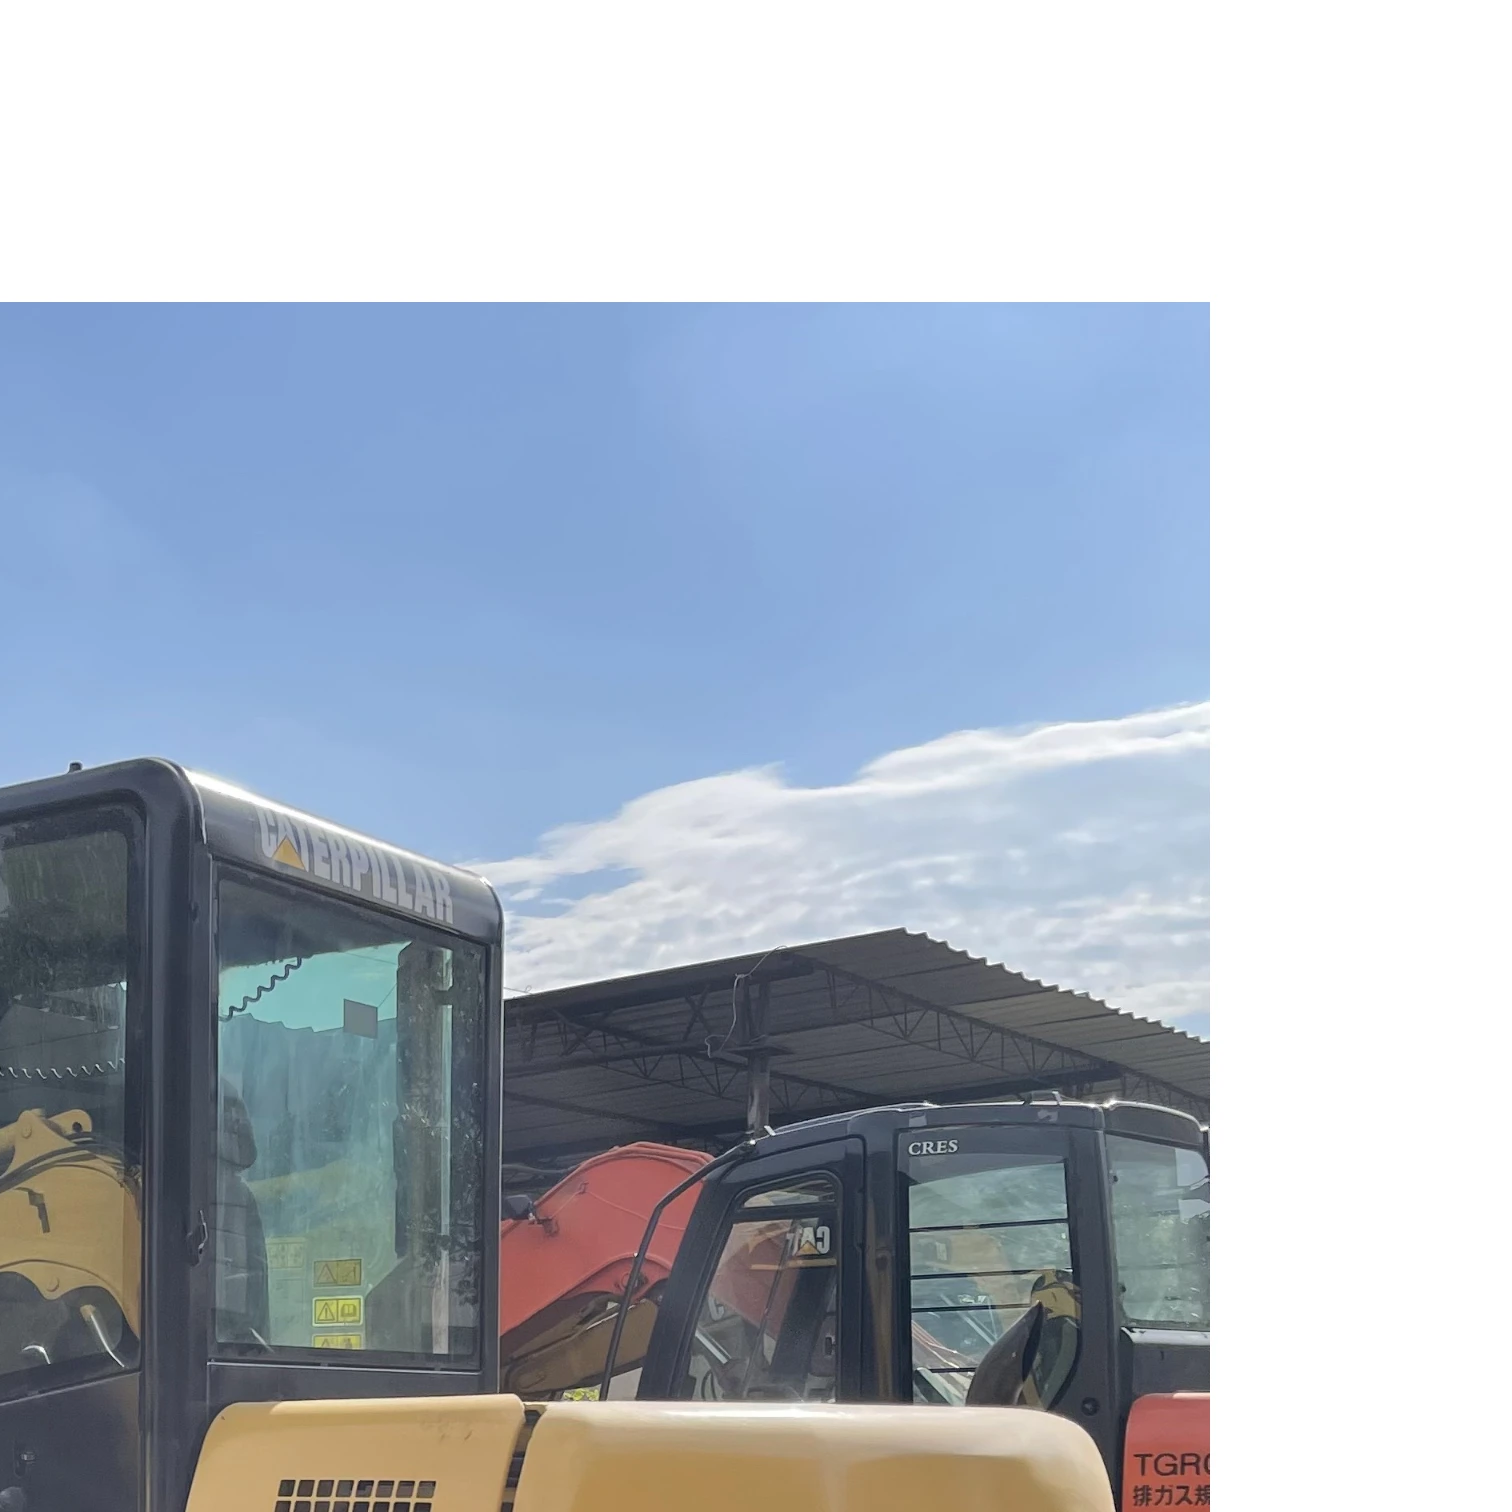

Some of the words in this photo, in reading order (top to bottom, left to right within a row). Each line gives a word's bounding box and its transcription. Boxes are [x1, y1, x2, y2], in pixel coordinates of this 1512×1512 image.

[255, 804, 454, 925] CATERPILLAR
[908, 1139, 958, 1156] CRES
[1133, 1452, 1210, 1476] TGR
